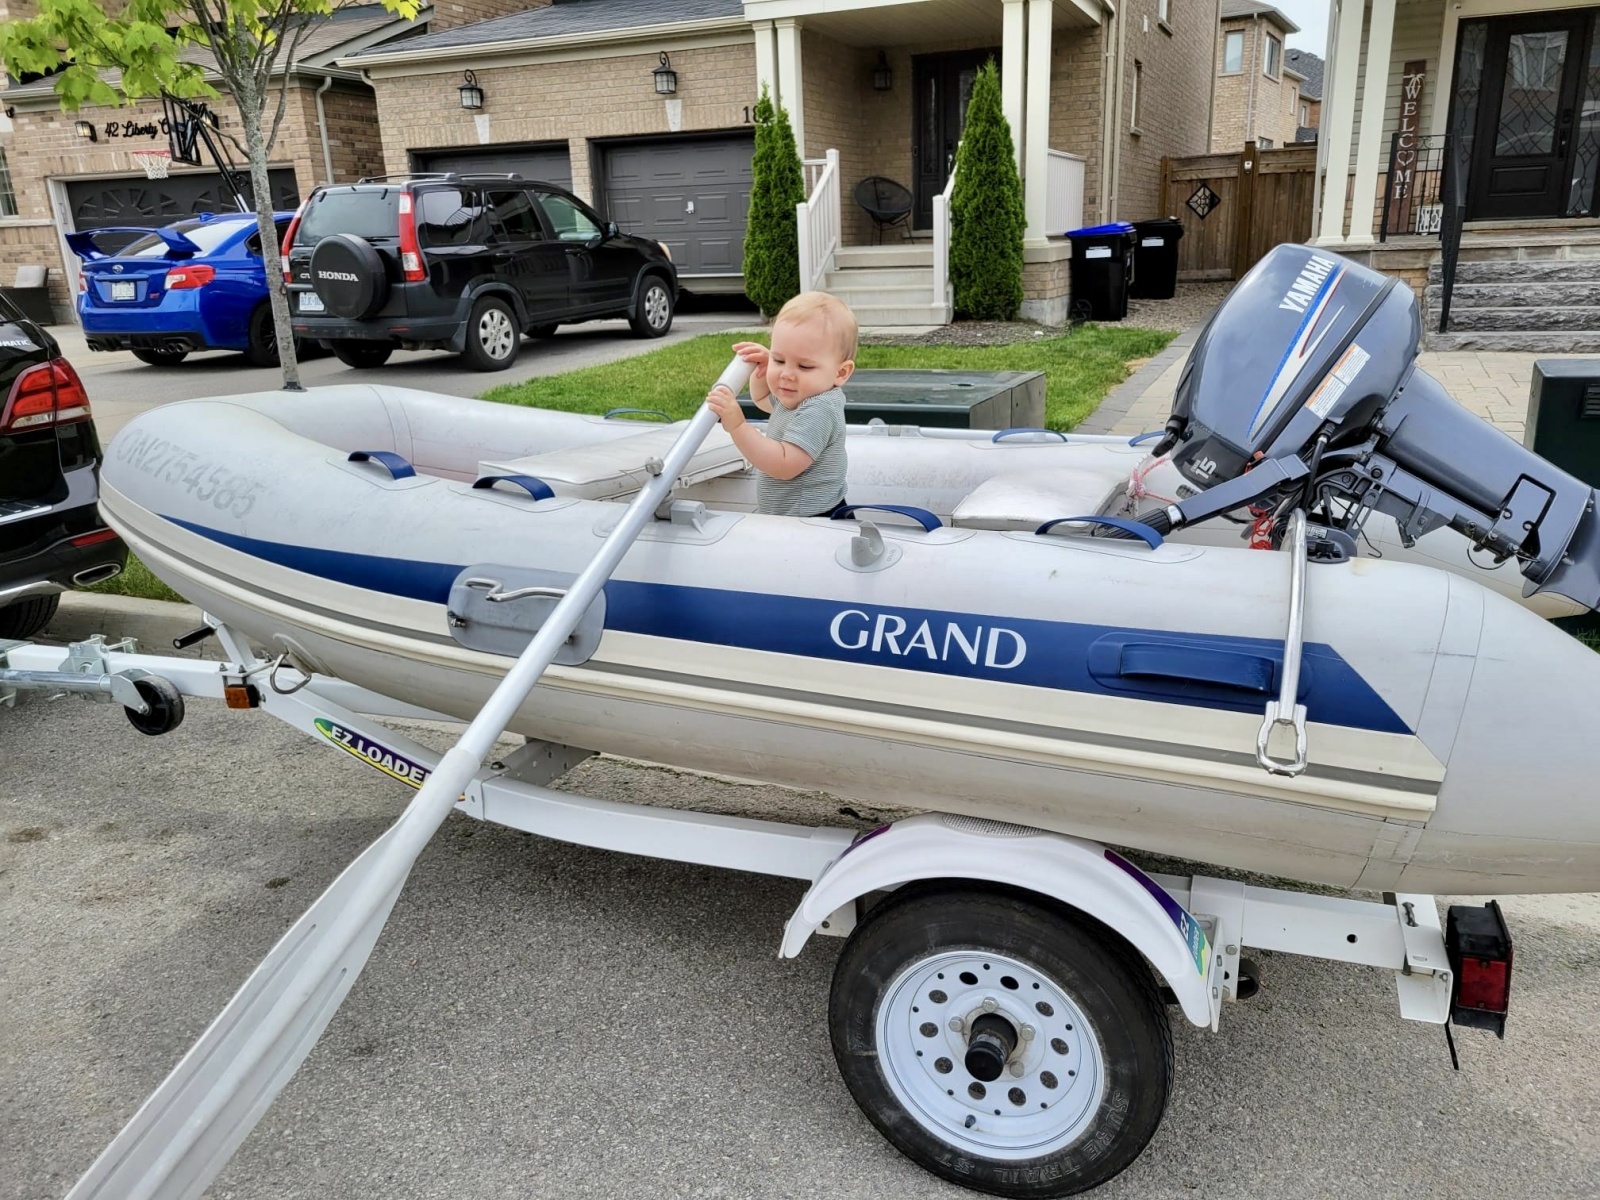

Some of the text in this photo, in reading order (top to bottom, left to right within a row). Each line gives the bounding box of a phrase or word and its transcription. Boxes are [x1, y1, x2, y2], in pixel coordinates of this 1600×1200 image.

[105, 122, 119, 137] 42
[122, 121, 158, 139] Liberty
[317, 270, 360, 282] HONDA
[1278, 254, 1336, 314] YAMAHA
[1195, 456, 1217, 479] 15
[829, 609, 1027, 669] GRAND
[330, 725, 353, 747] EZ
[1180, 911, 1190, 942] EZ
[1081, 1090, 1130, 1161] SURE
[993, 1156, 1081, 1184] TRAIL
